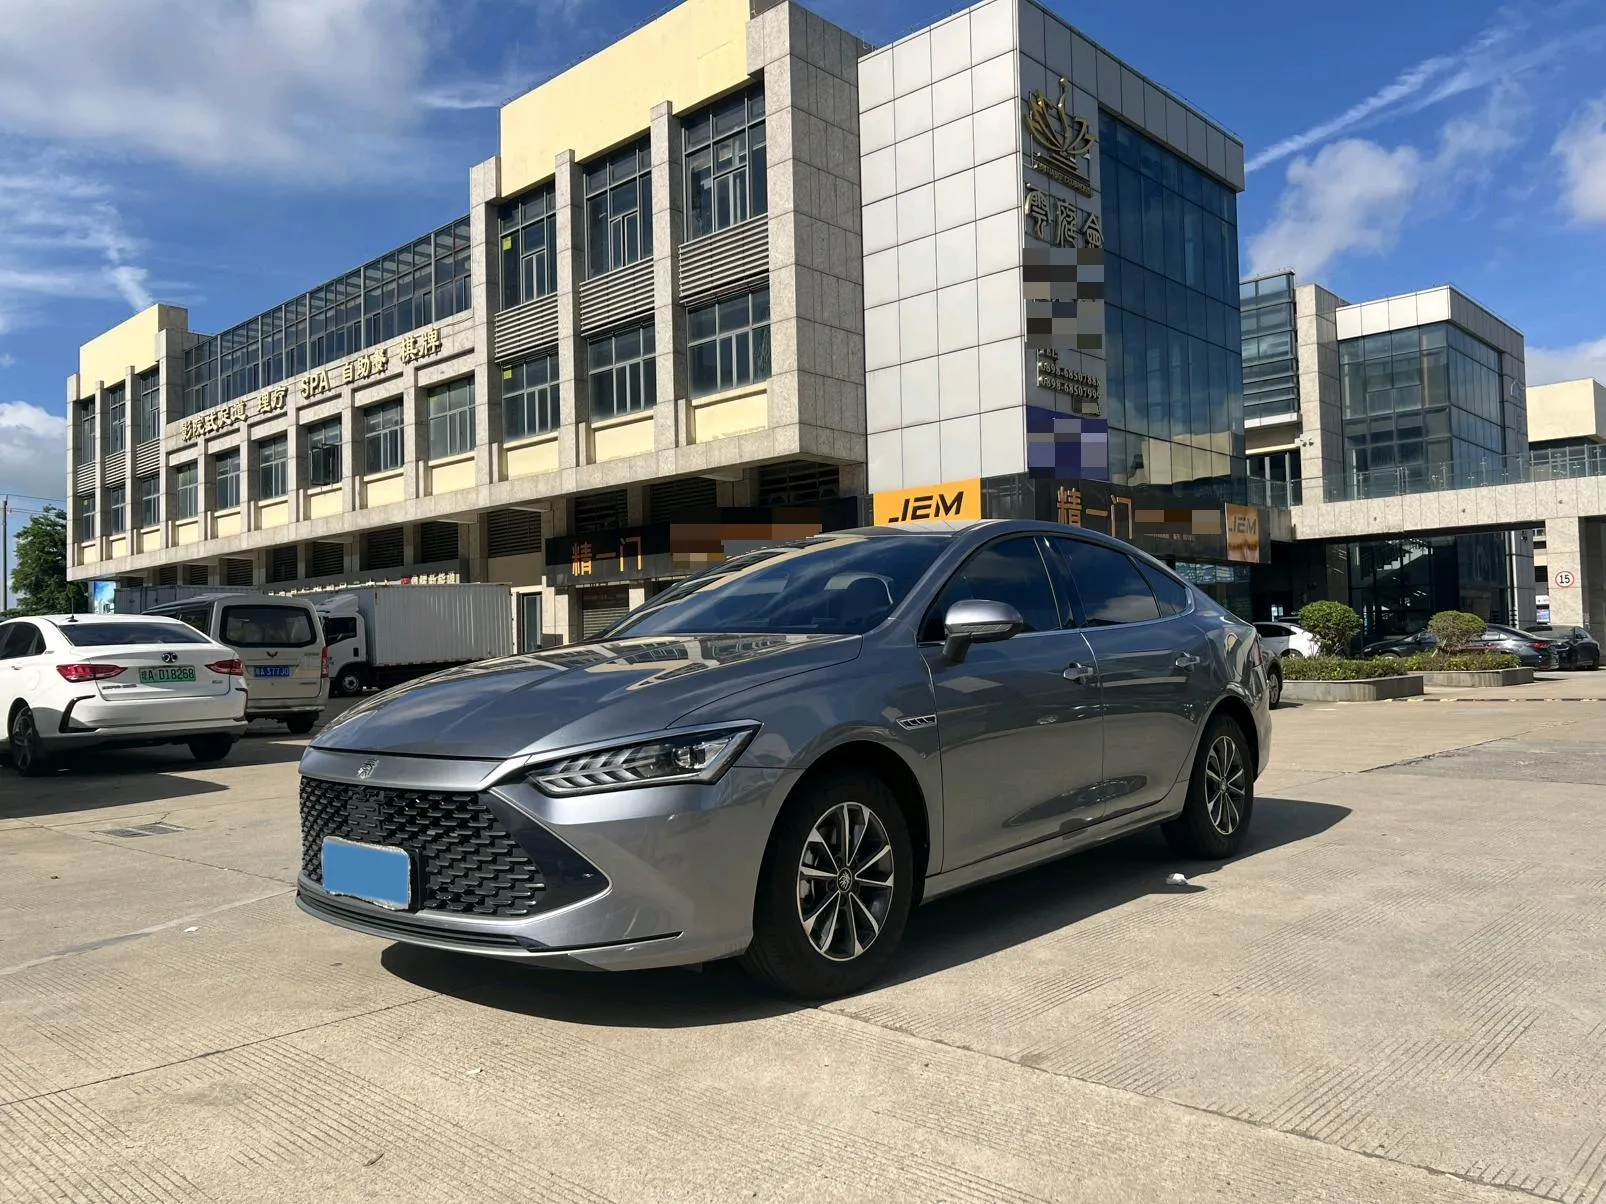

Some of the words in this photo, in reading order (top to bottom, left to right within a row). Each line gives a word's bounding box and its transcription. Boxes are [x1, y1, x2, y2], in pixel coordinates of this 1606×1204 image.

[257, 386, 288, 413] 理疗
[300, 370, 331, 398] SPA
[342, 349, 388, 383] 自助餐
[401, 329, 442, 363] 棋牌
[888, 491, 964, 523] JEM
[1057, 486, 1133, 540] 精一门
[572, 537, 642, 577] 精一门
[1559, 574, 1571, 585] 15
